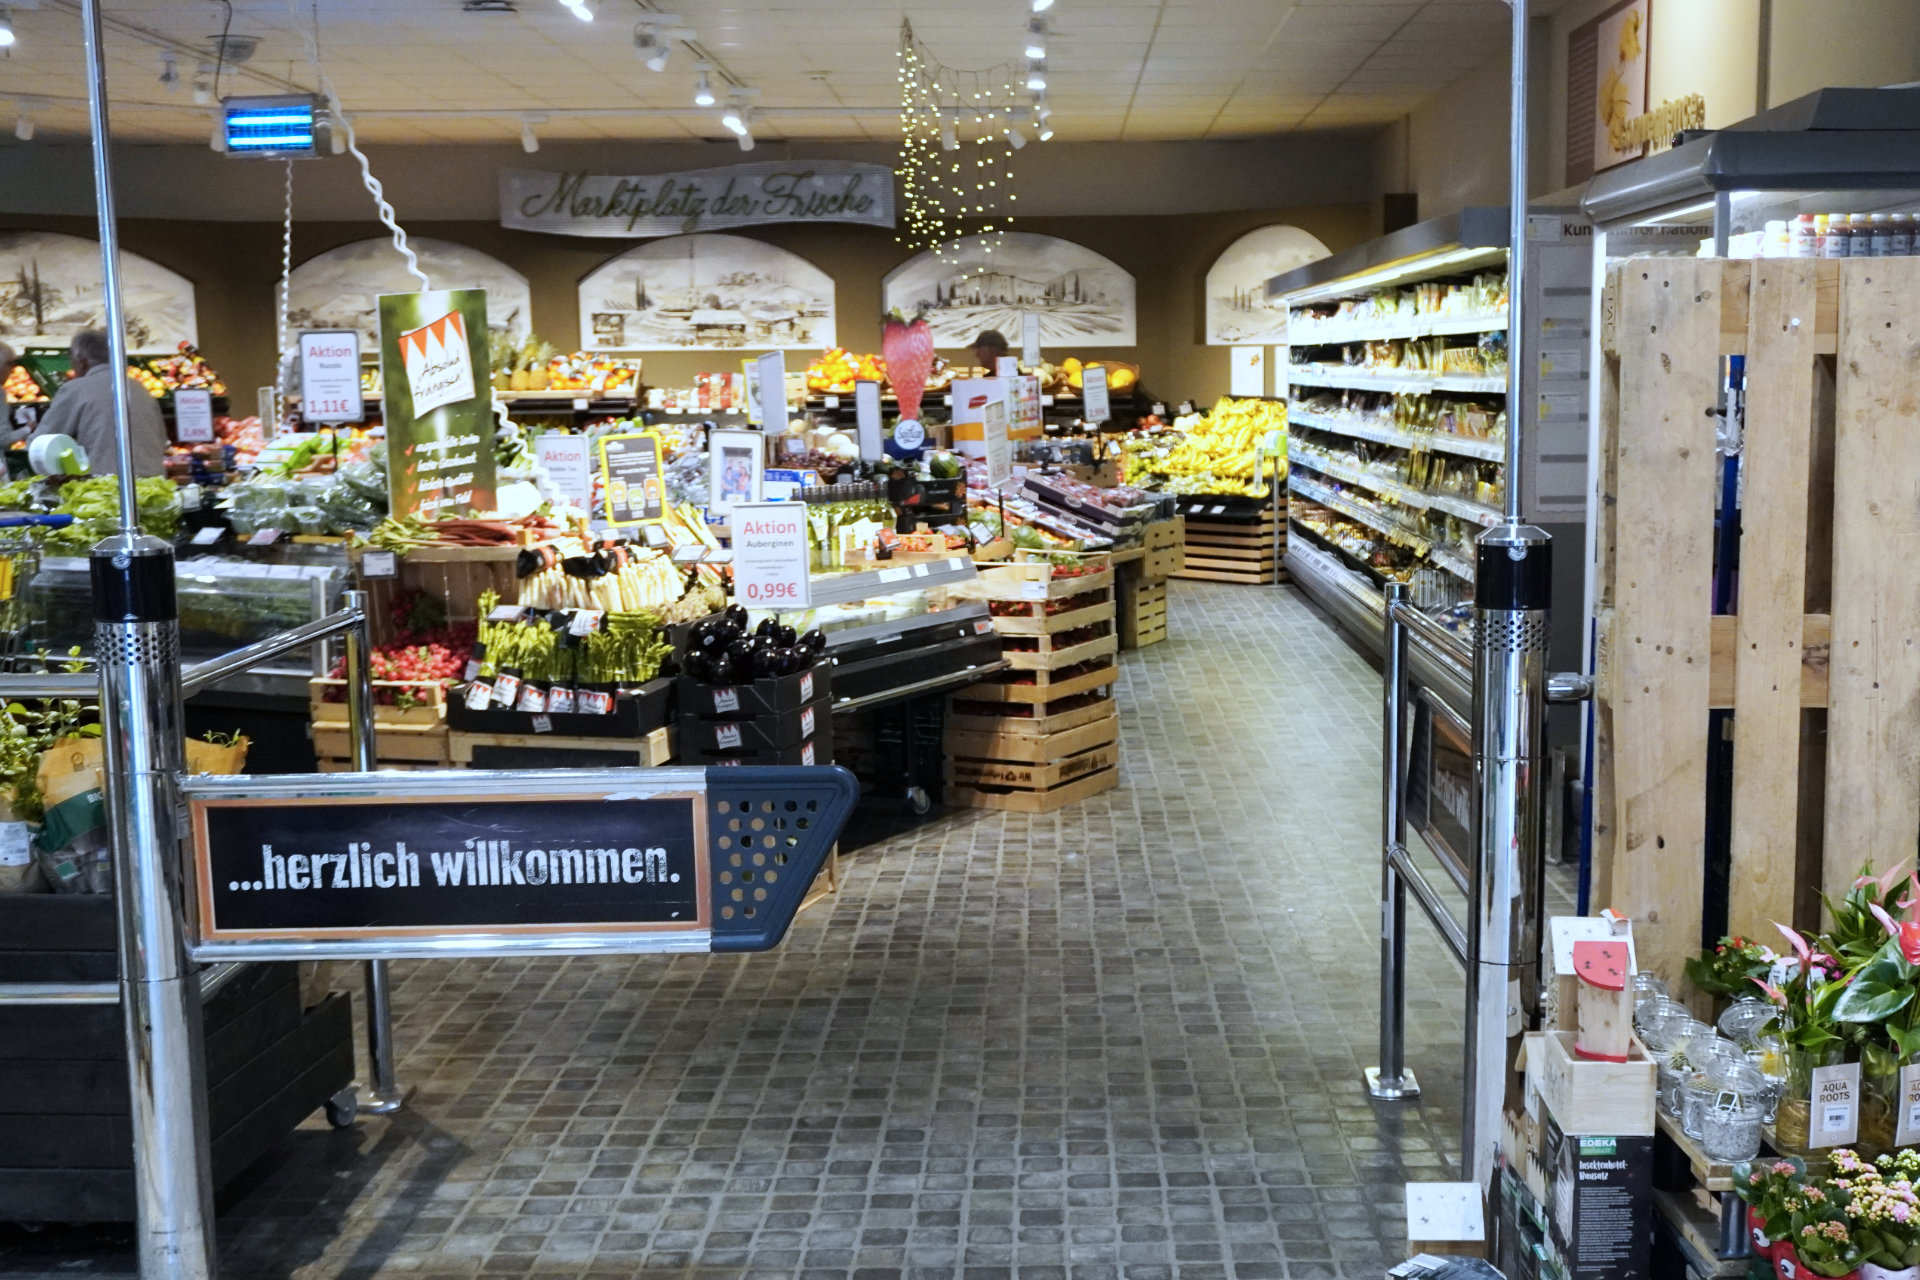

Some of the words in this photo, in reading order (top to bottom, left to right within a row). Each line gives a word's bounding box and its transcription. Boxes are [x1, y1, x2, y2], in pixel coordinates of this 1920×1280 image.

[521, 168, 706, 233] Marktplatz
[710, 177, 759, 217] der
[762, 170, 874, 218] Frische
[309, 345, 352, 358] Aktion
[309, 399, 350, 416] 1,11€
[544, 450, 582, 462] Aktion
[744, 520, 796, 535] Aktion
[746, 540, 794, 548] Auberginen
[747, 582, 798, 600] 0,99€
[230, 842, 420, 892] ...herzlich
[431, 840, 681, 887] willkommen.
[1822, 1081, 1848, 1093] AQUA
[1819, 1091, 1850, 1103] ROOTS
[1579, 1139, 1617, 1147] EDEKA
